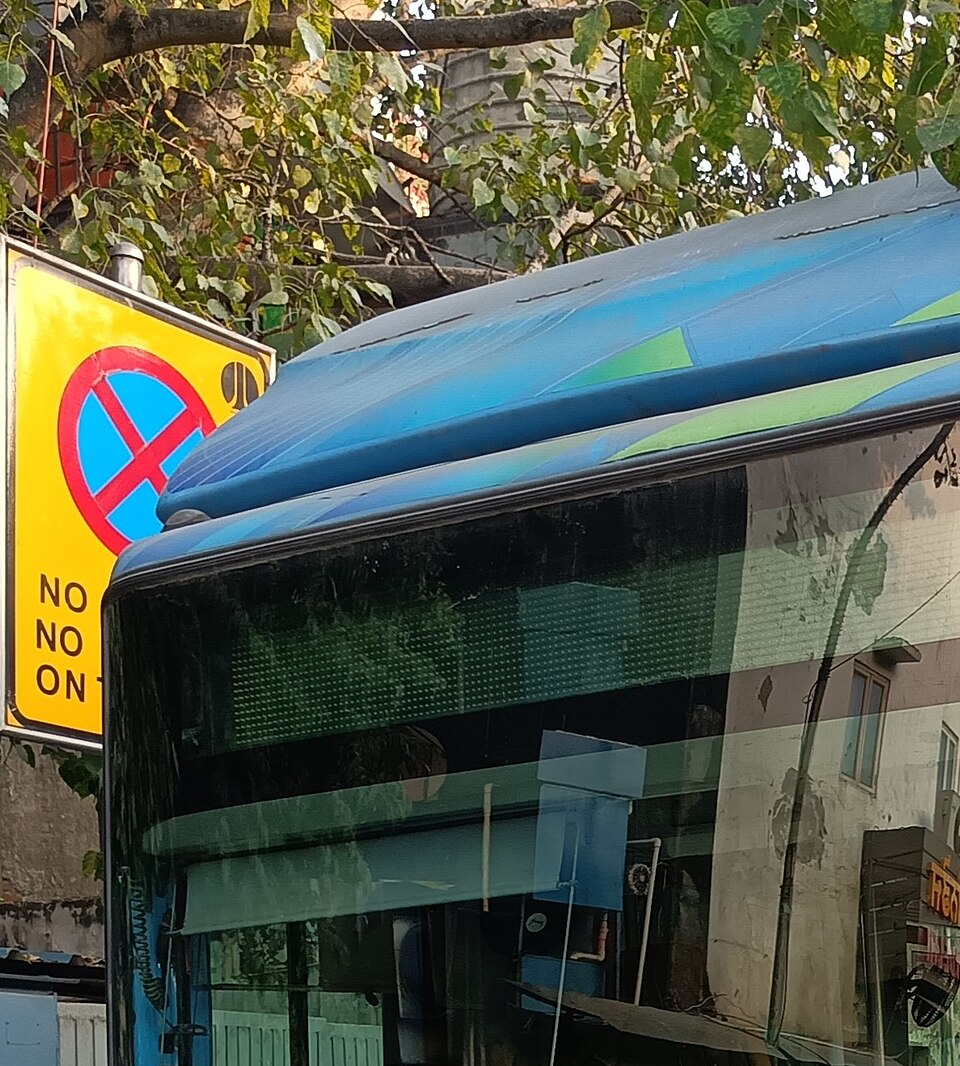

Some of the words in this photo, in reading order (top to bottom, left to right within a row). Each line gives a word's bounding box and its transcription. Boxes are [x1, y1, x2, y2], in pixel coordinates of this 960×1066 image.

[39, 574, 88, 614] NO
[35, 618, 83, 658] NO
[36, 664, 86, 702] ON
